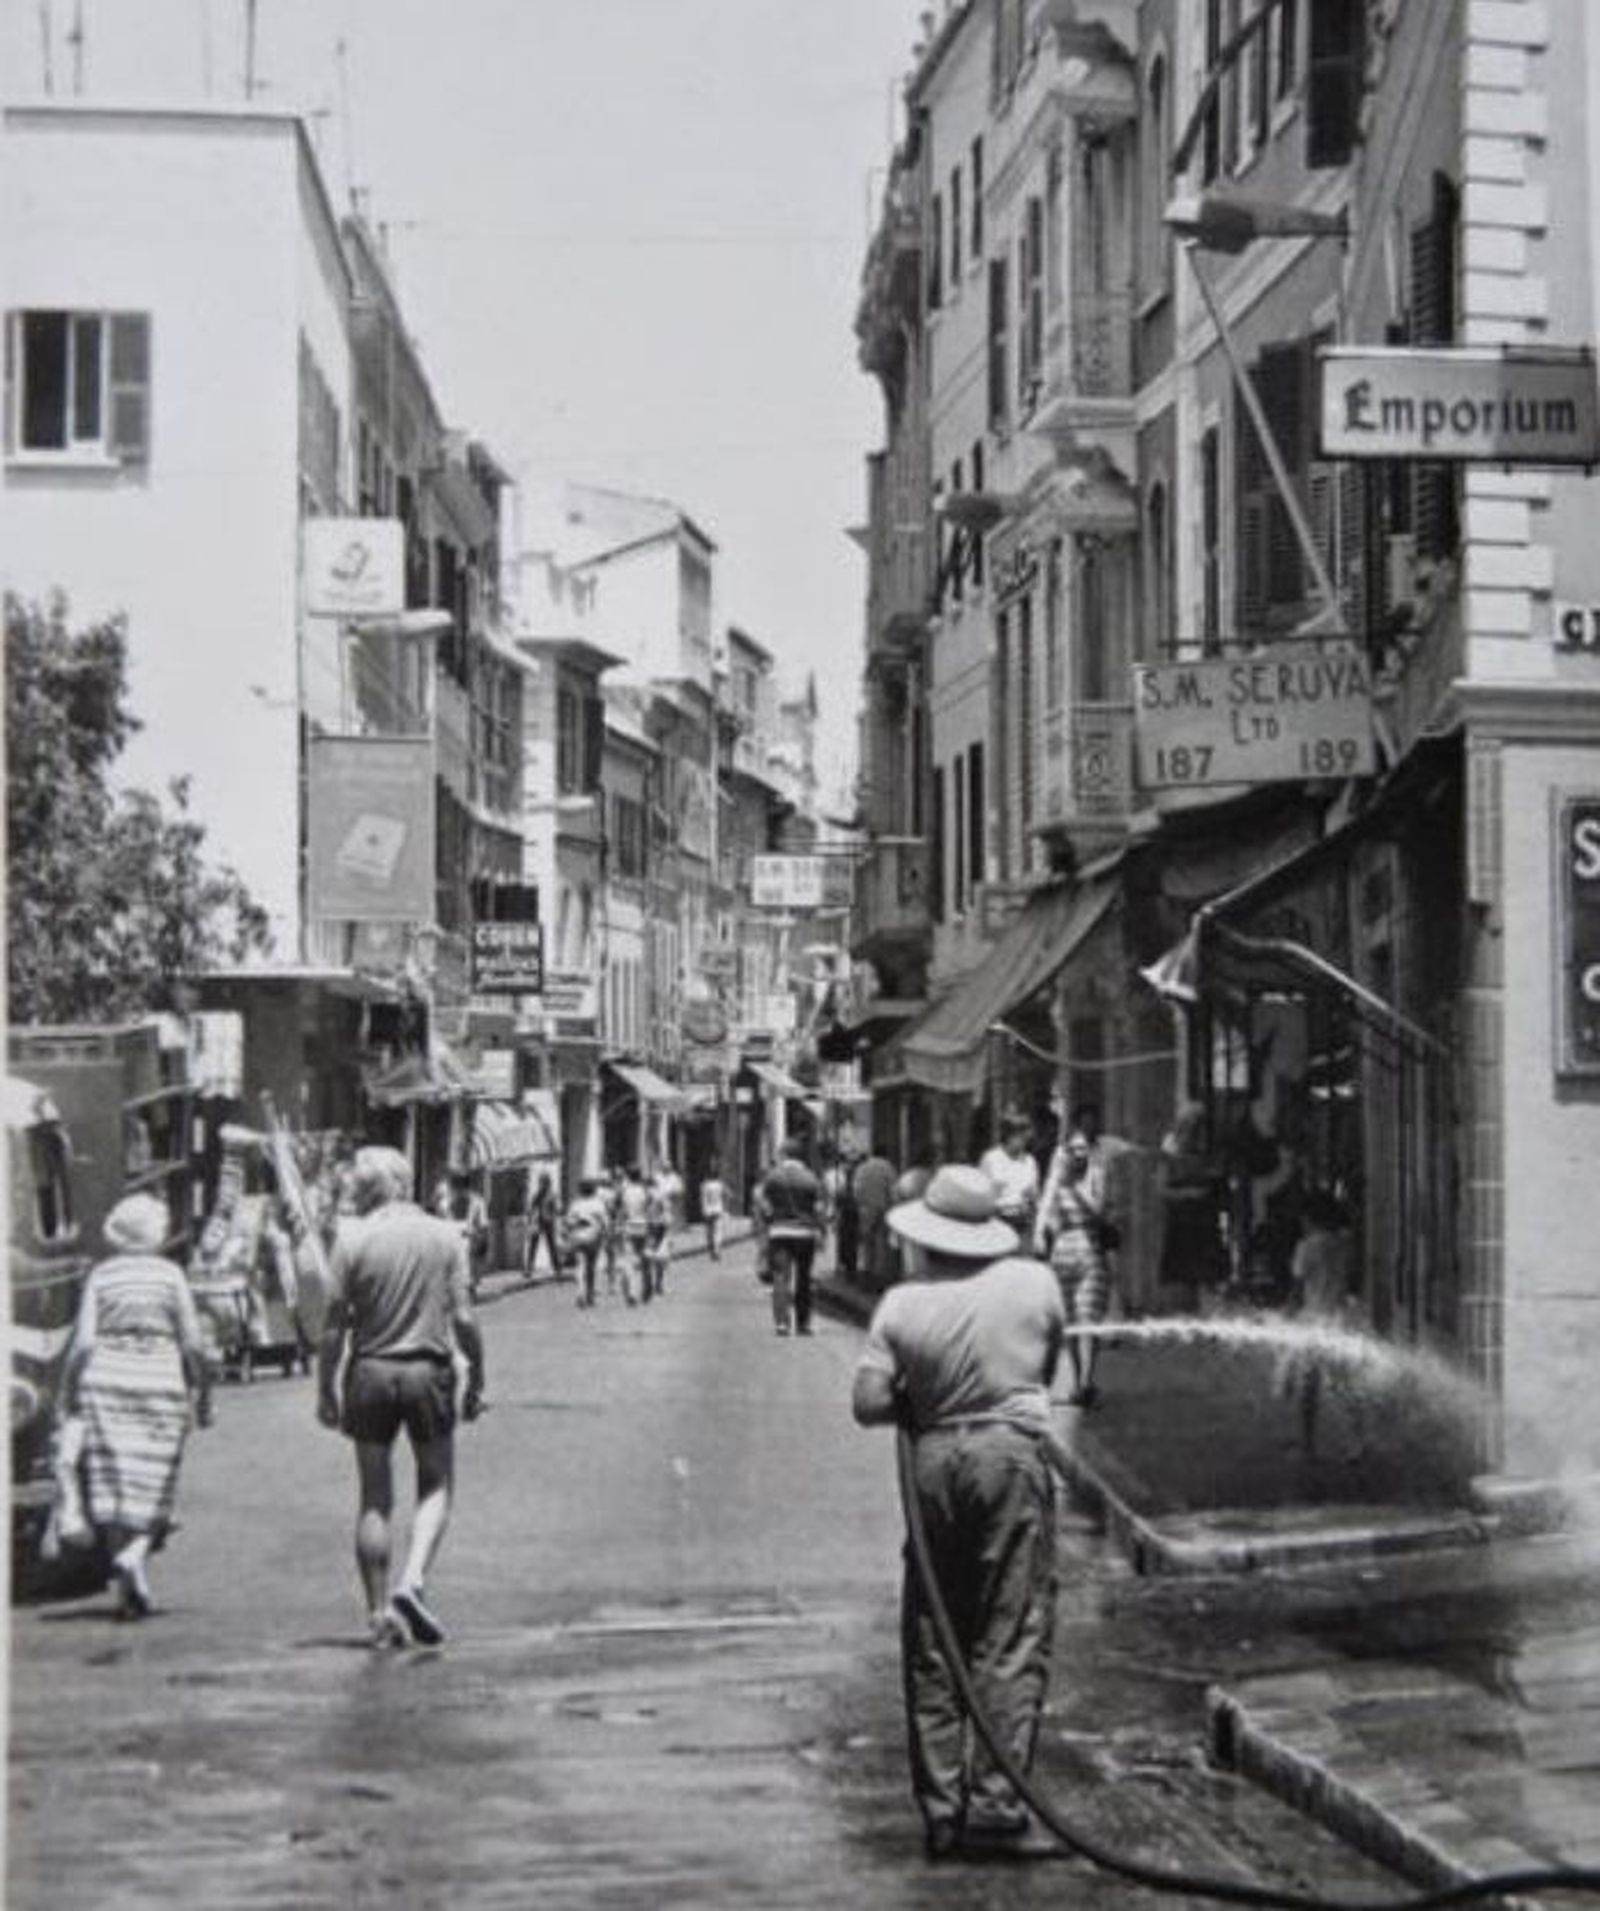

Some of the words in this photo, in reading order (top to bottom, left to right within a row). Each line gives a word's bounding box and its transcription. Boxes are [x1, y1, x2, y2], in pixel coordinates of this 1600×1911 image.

[1343, 378, 1577, 447] Emporium
[1142, 672, 1213, 710] S.M.
[1228, 659, 1371, 705] SERUYA
[1156, 745, 1214, 781] 187
[1300, 737, 1358, 774] 189
